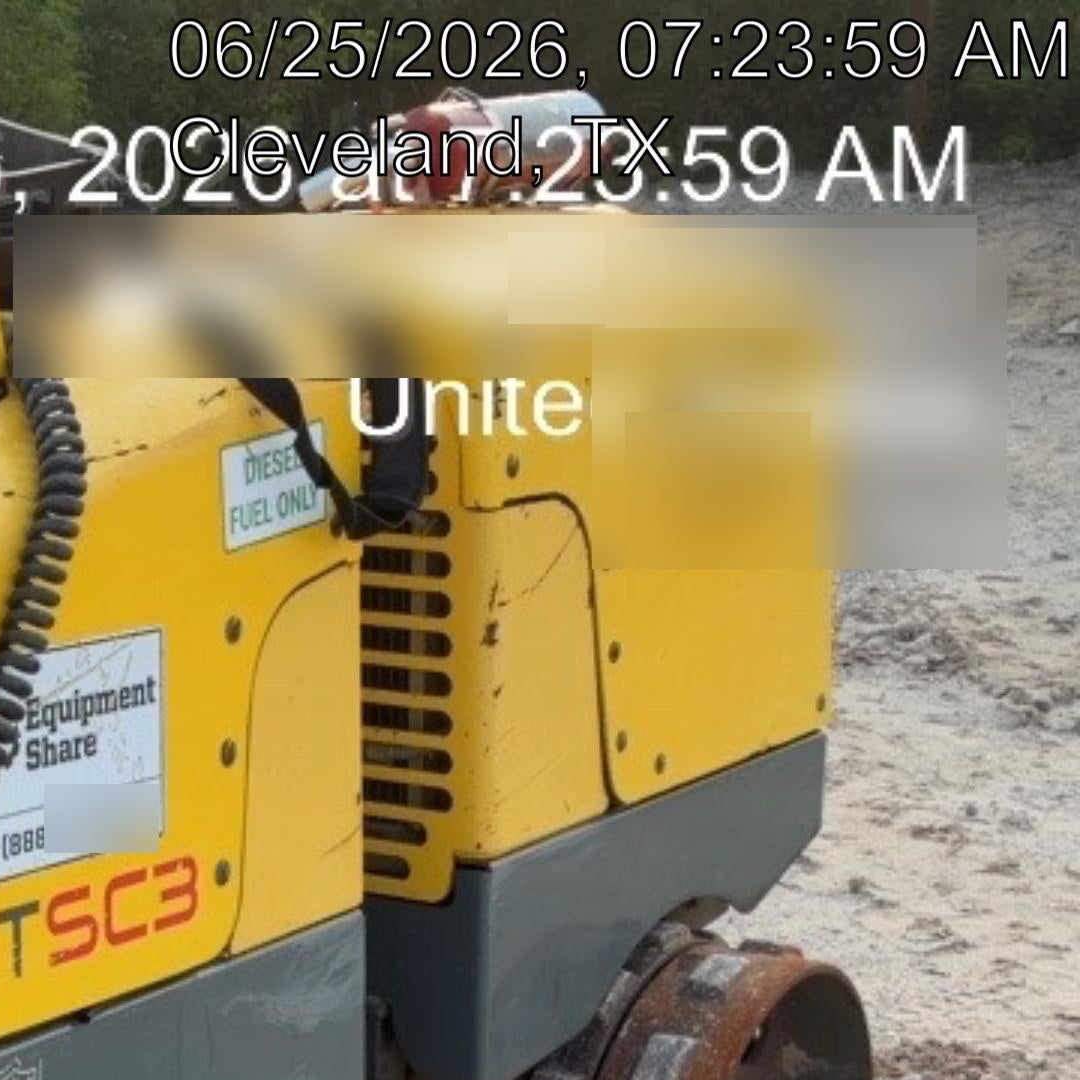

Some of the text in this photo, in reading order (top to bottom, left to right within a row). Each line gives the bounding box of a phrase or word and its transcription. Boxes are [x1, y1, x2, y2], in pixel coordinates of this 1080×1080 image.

[230, 482, 318, 535] FUEL ONLY
[26, 675, 157, 733] Equipment
[26, 734, 98, 772] Share
